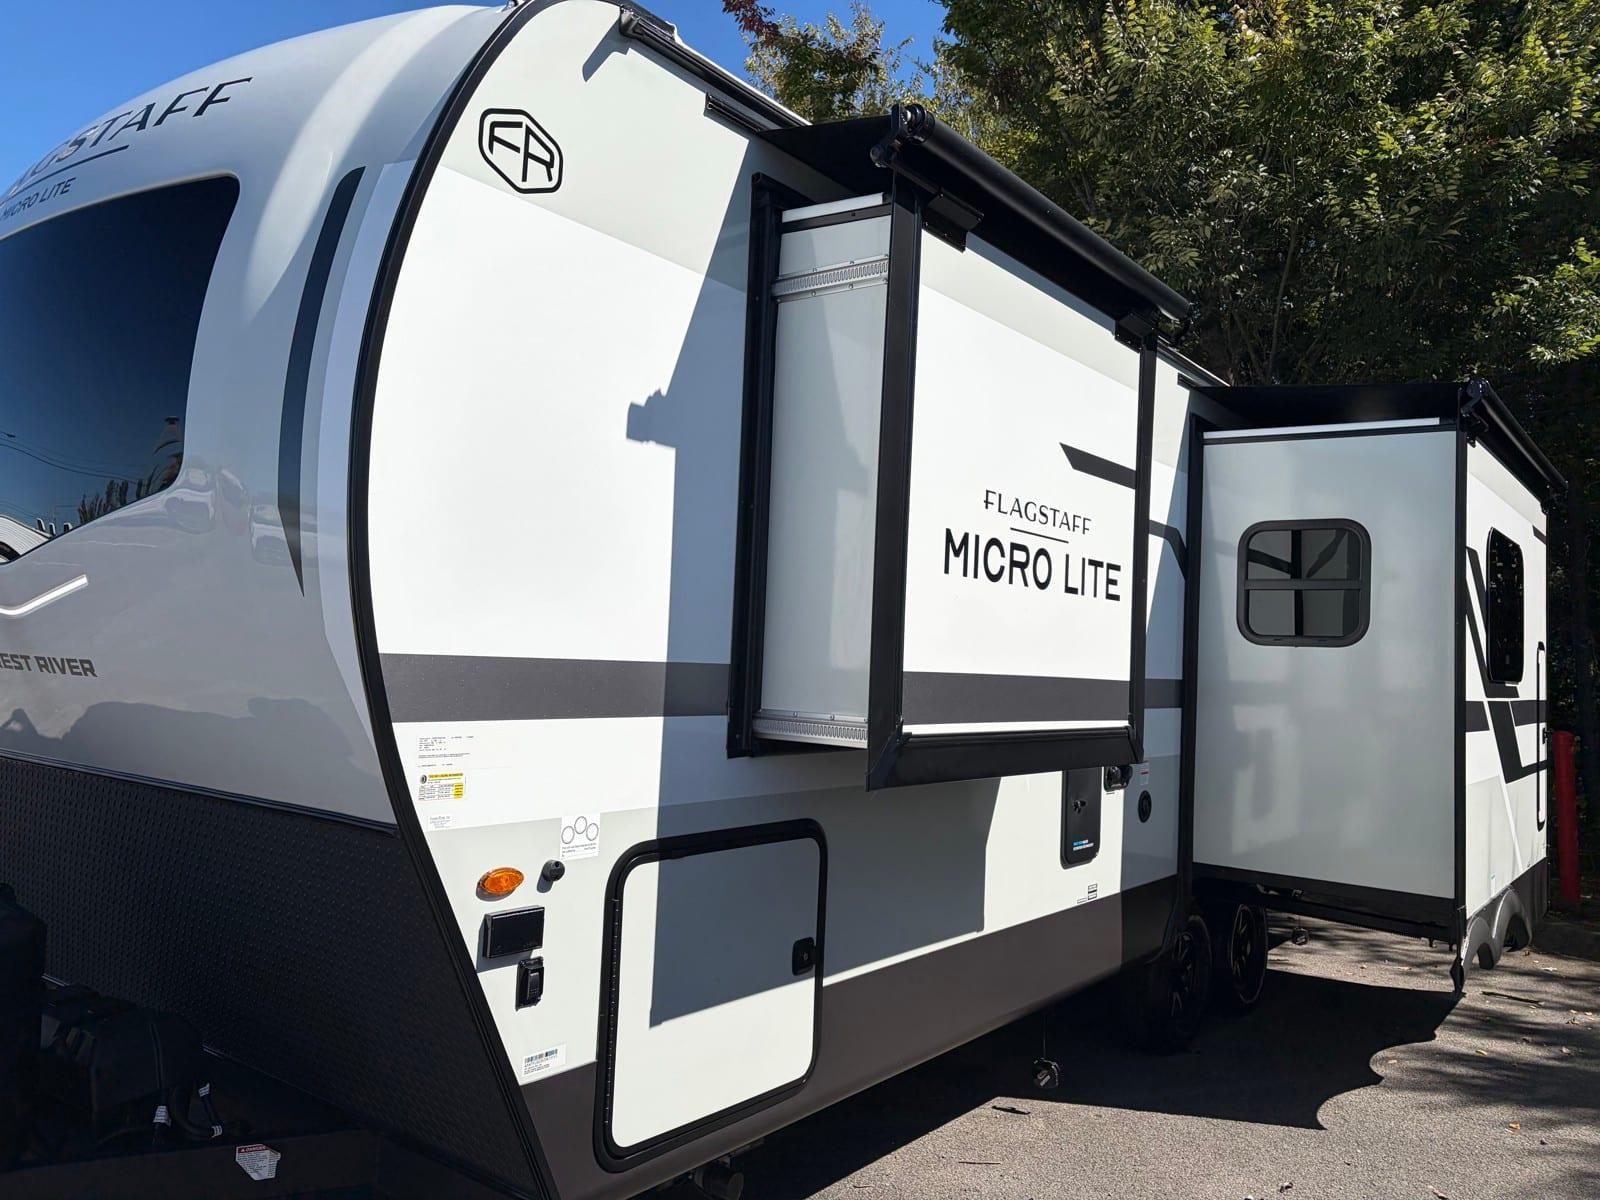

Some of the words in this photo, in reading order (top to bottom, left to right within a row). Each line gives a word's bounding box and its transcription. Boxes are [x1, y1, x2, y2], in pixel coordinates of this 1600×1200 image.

[39, 177, 76, 203] LITE
[983, 489, 1092, 535] FLAGSTAFF
[944, 528, 1052, 590] MICRO
[1064, 553, 1121, 602] LITE
[34, 655, 98, 678] RIVER
